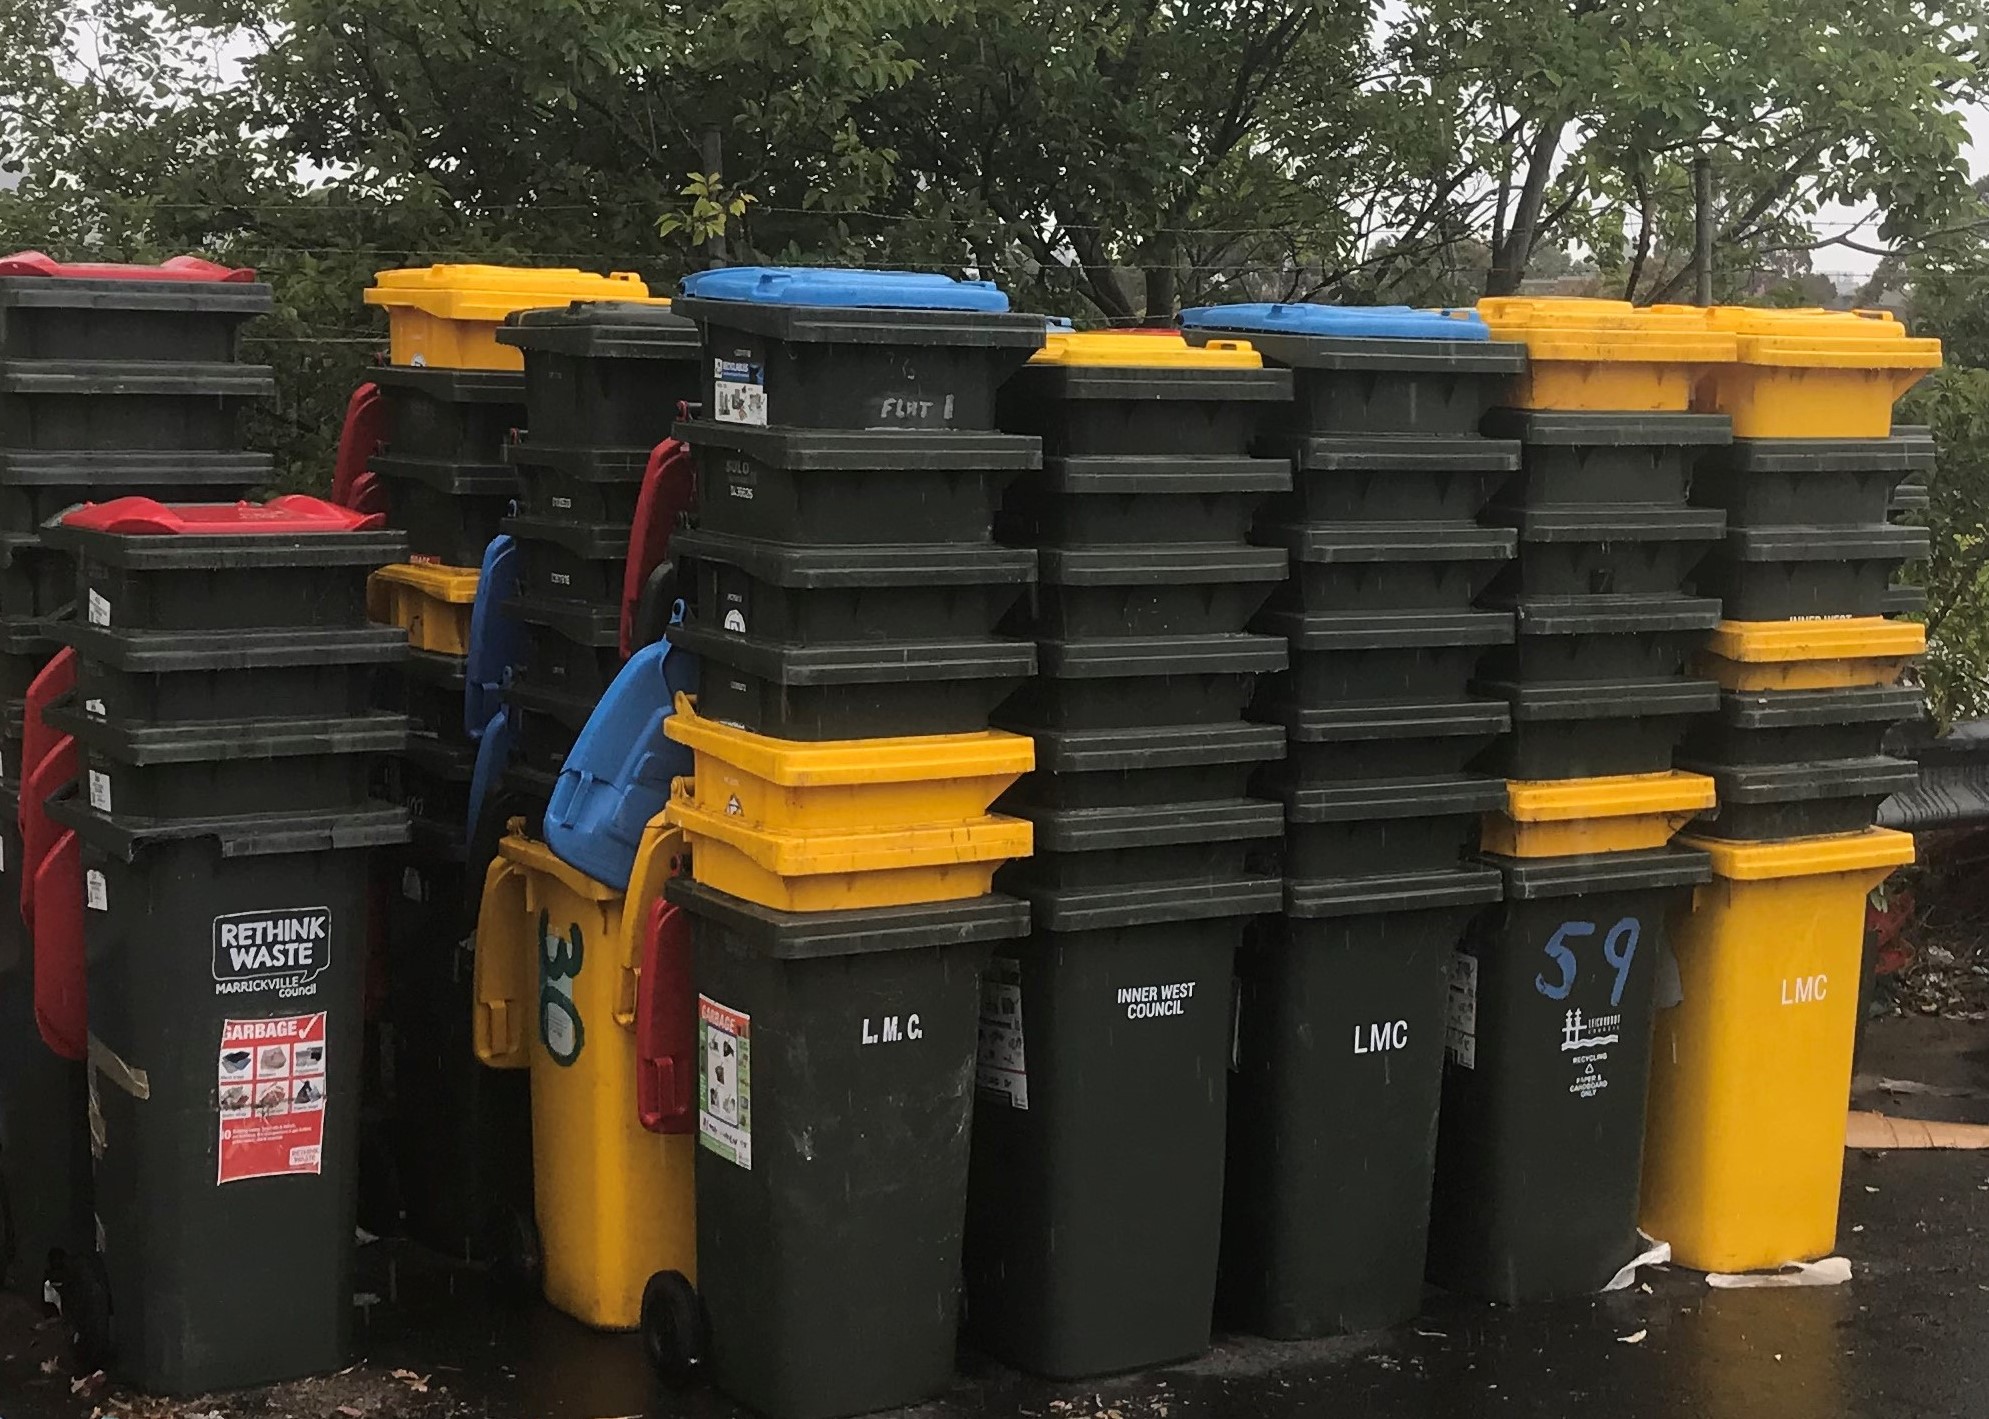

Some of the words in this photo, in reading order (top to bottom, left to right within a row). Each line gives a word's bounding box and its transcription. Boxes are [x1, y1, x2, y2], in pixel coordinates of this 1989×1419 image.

[881, 397, 933, 418] FLAT
[221, 916, 326, 948] RETHINK
[229, 942, 314, 972] WASTE
[1535, 917, 1641, 1007] 59
[215, 976, 300, 995] MARRICKVILLE
[278, 983, 318, 998] council
[1117, 986, 1158, 1004] INNER
[1160, 981, 1196, 1000] WEST
[1781, 974, 1828, 1005] LMC
[1127, 999, 1185, 1020] COUNCIL
[1354, 1019, 1408, 1054] LMC
[1572, 1052, 1608, 1064] RECYCLING
